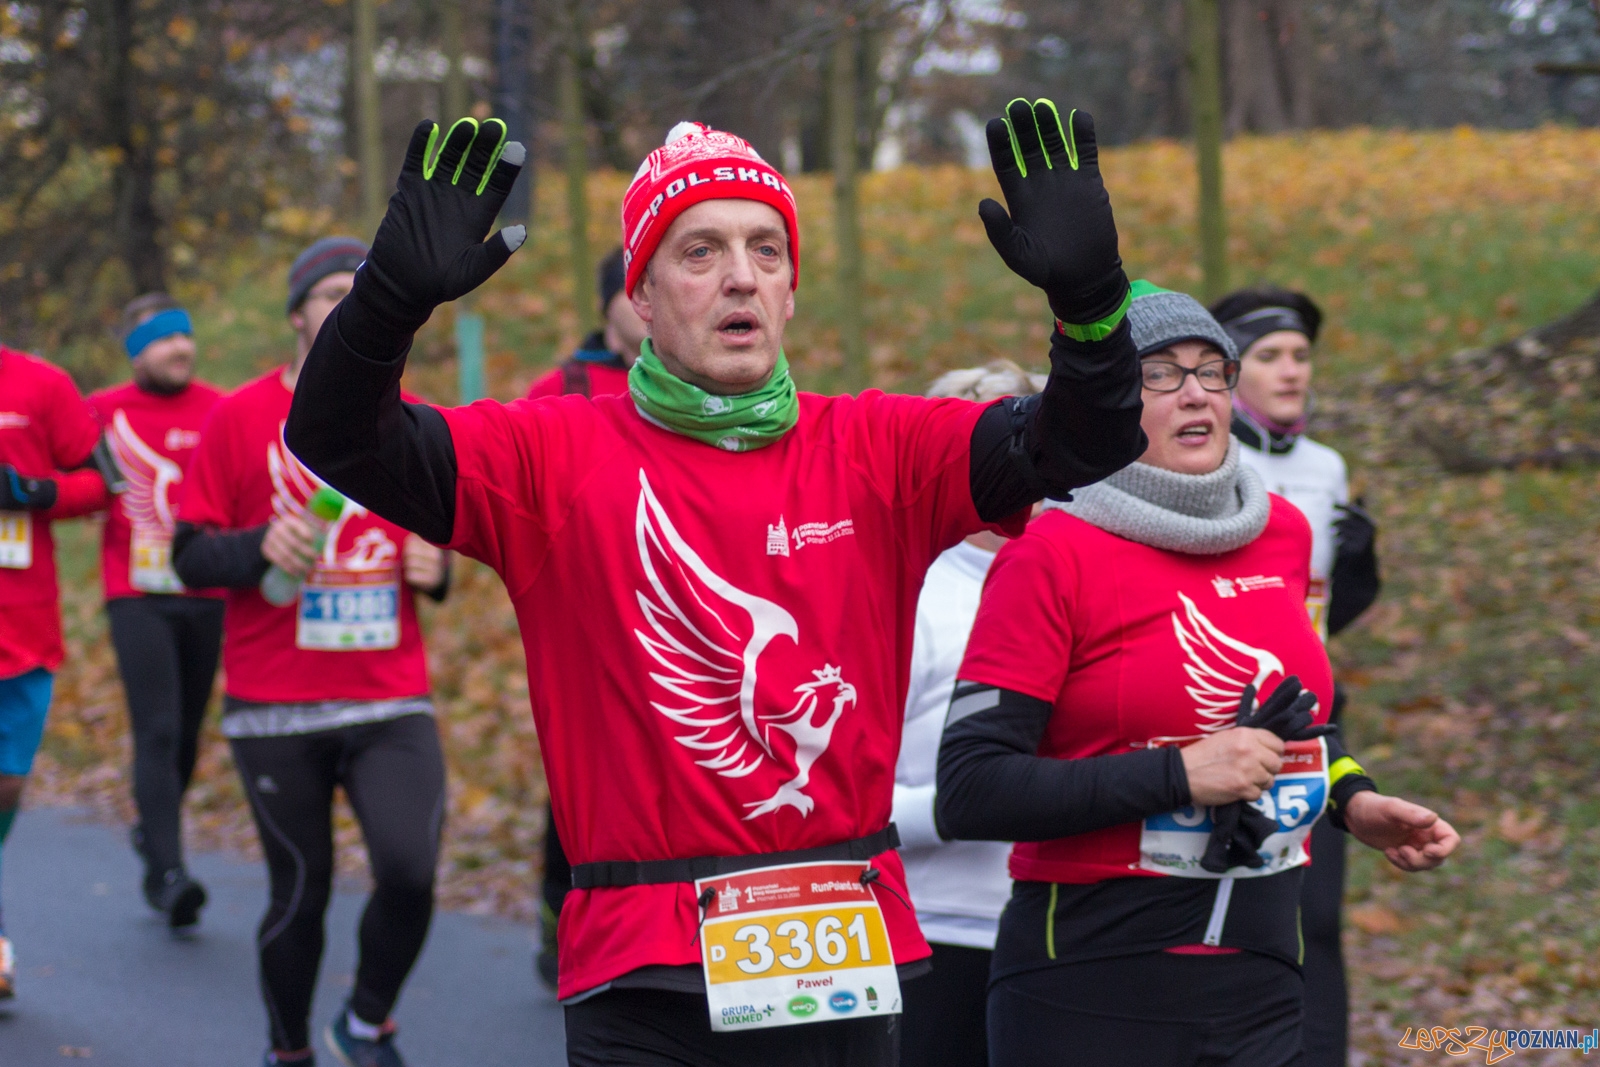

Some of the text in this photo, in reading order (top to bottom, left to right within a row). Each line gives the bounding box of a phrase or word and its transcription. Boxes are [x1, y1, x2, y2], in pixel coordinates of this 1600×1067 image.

[650, 167, 782, 216] POLSKA
[710, 913, 872, 974] D 3361
[797, 976, 833, 989] Paweł
[722, 1005, 756, 1017] GRUPA
[722, 1013, 763, 1025] LUXMED
